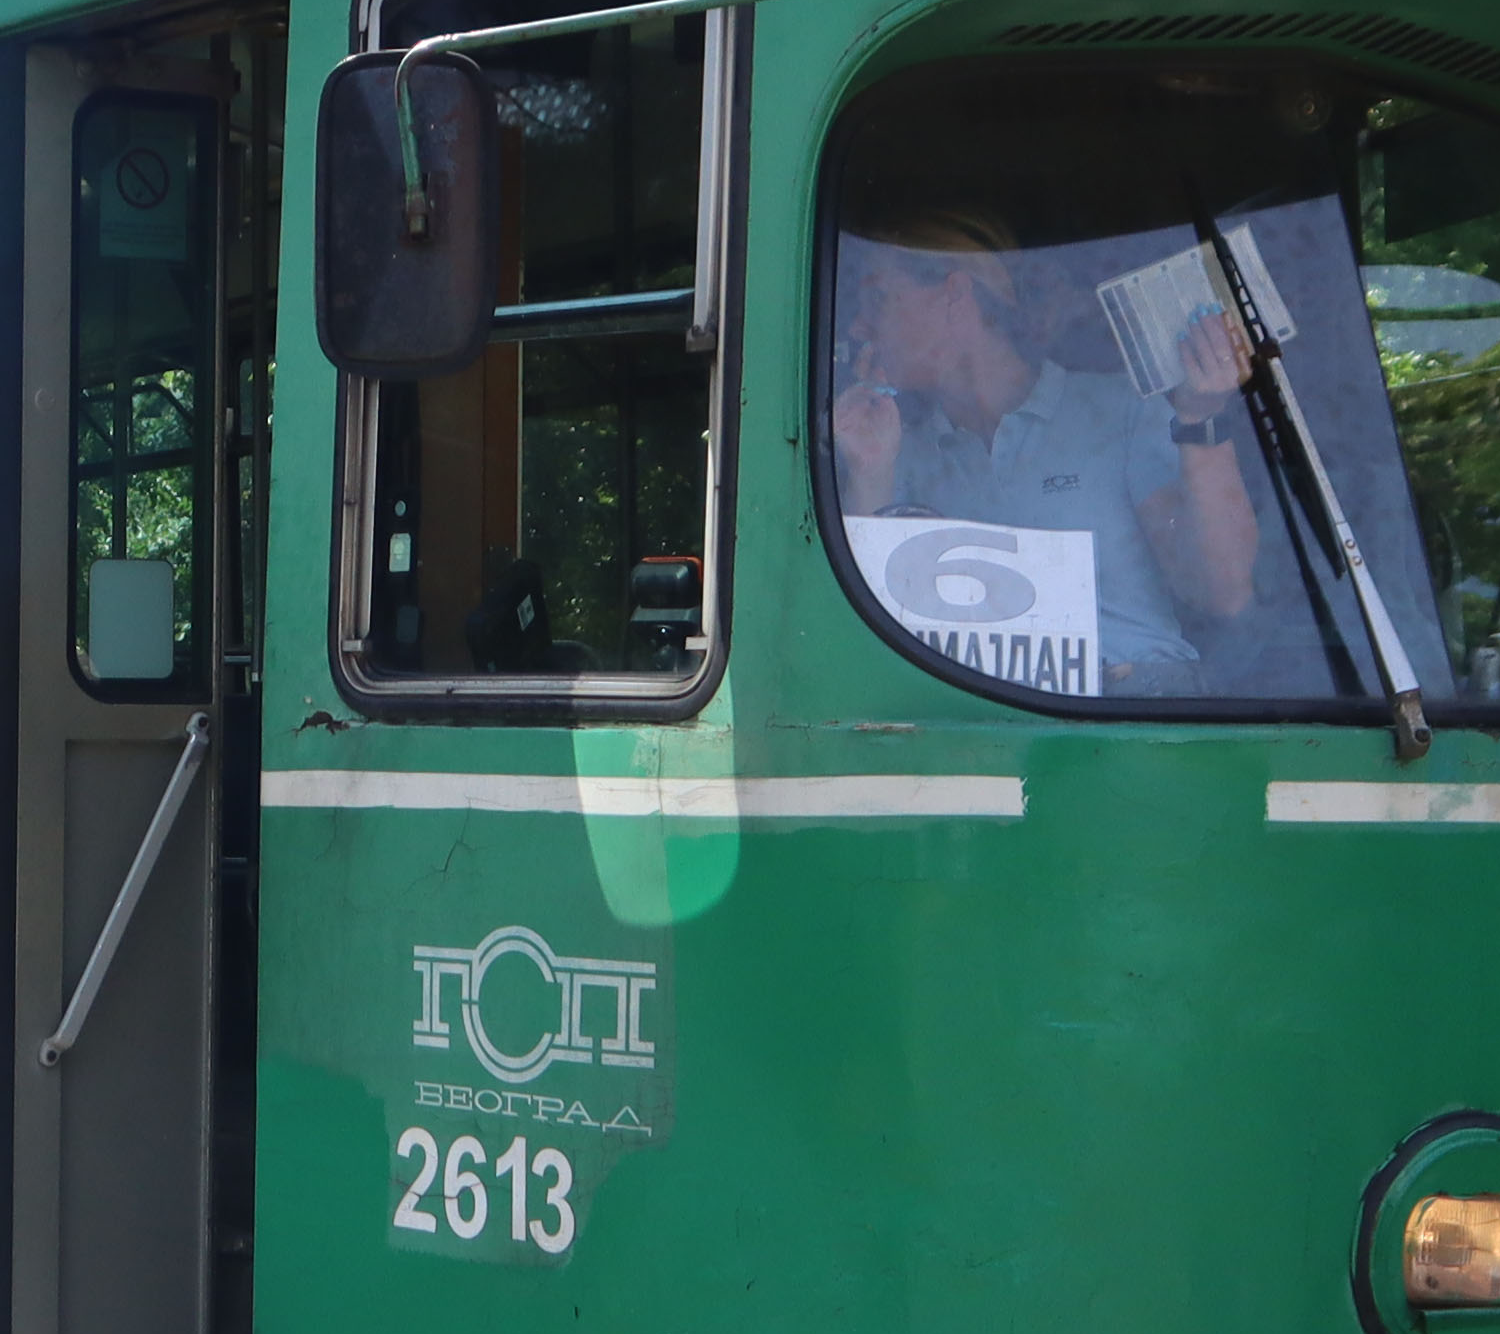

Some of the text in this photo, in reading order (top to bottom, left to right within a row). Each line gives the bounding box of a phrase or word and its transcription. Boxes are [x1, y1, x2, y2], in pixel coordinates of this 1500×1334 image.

[884, 526, 1037, 624] 6
[412, 925, 657, 1084] ГСП
[413, 1081, 652, 1138] БЕОГРАД
[392, 1126, 576, 1254] 2613
